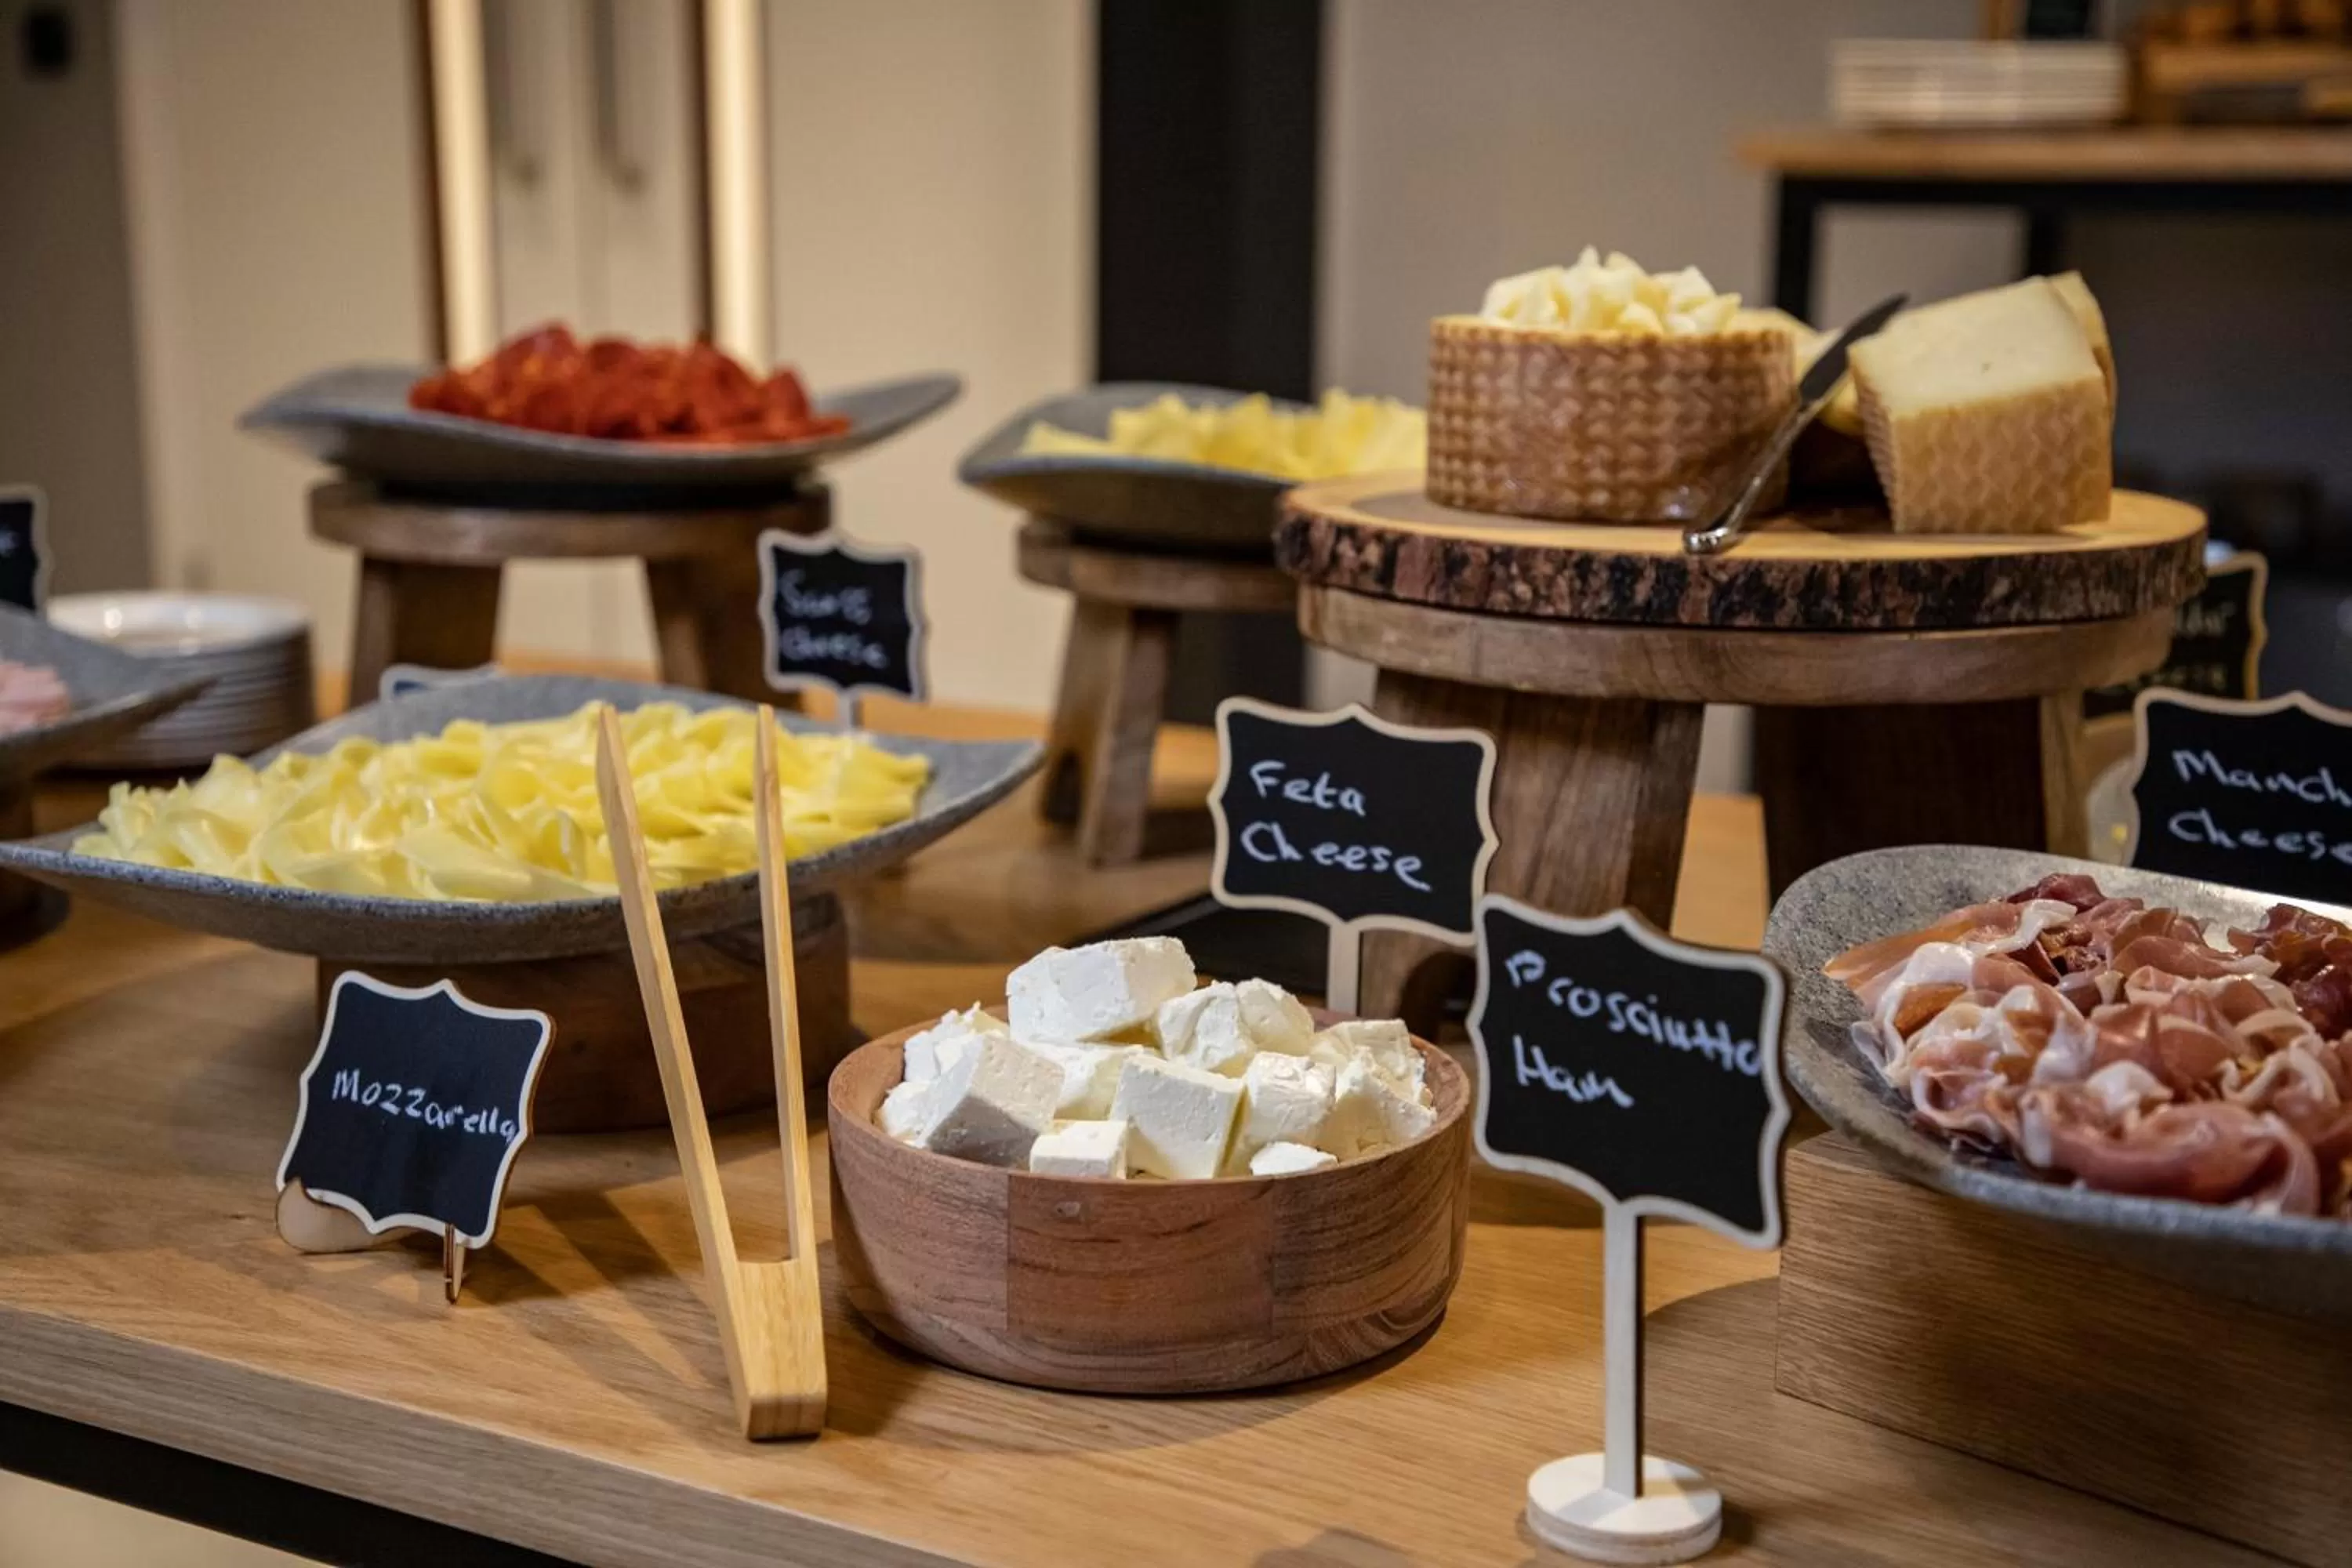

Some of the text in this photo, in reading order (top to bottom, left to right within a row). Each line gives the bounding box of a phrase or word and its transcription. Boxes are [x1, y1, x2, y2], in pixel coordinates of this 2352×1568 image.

[1250, 760, 1366, 816] Feta
[1240, 822, 1432, 891] Cheese
[1505, 950, 1762, 1077] Prosciutto
[332, 1069, 518, 1143] Mozzarella
[1513, 1034, 1635, 1108] Ham
